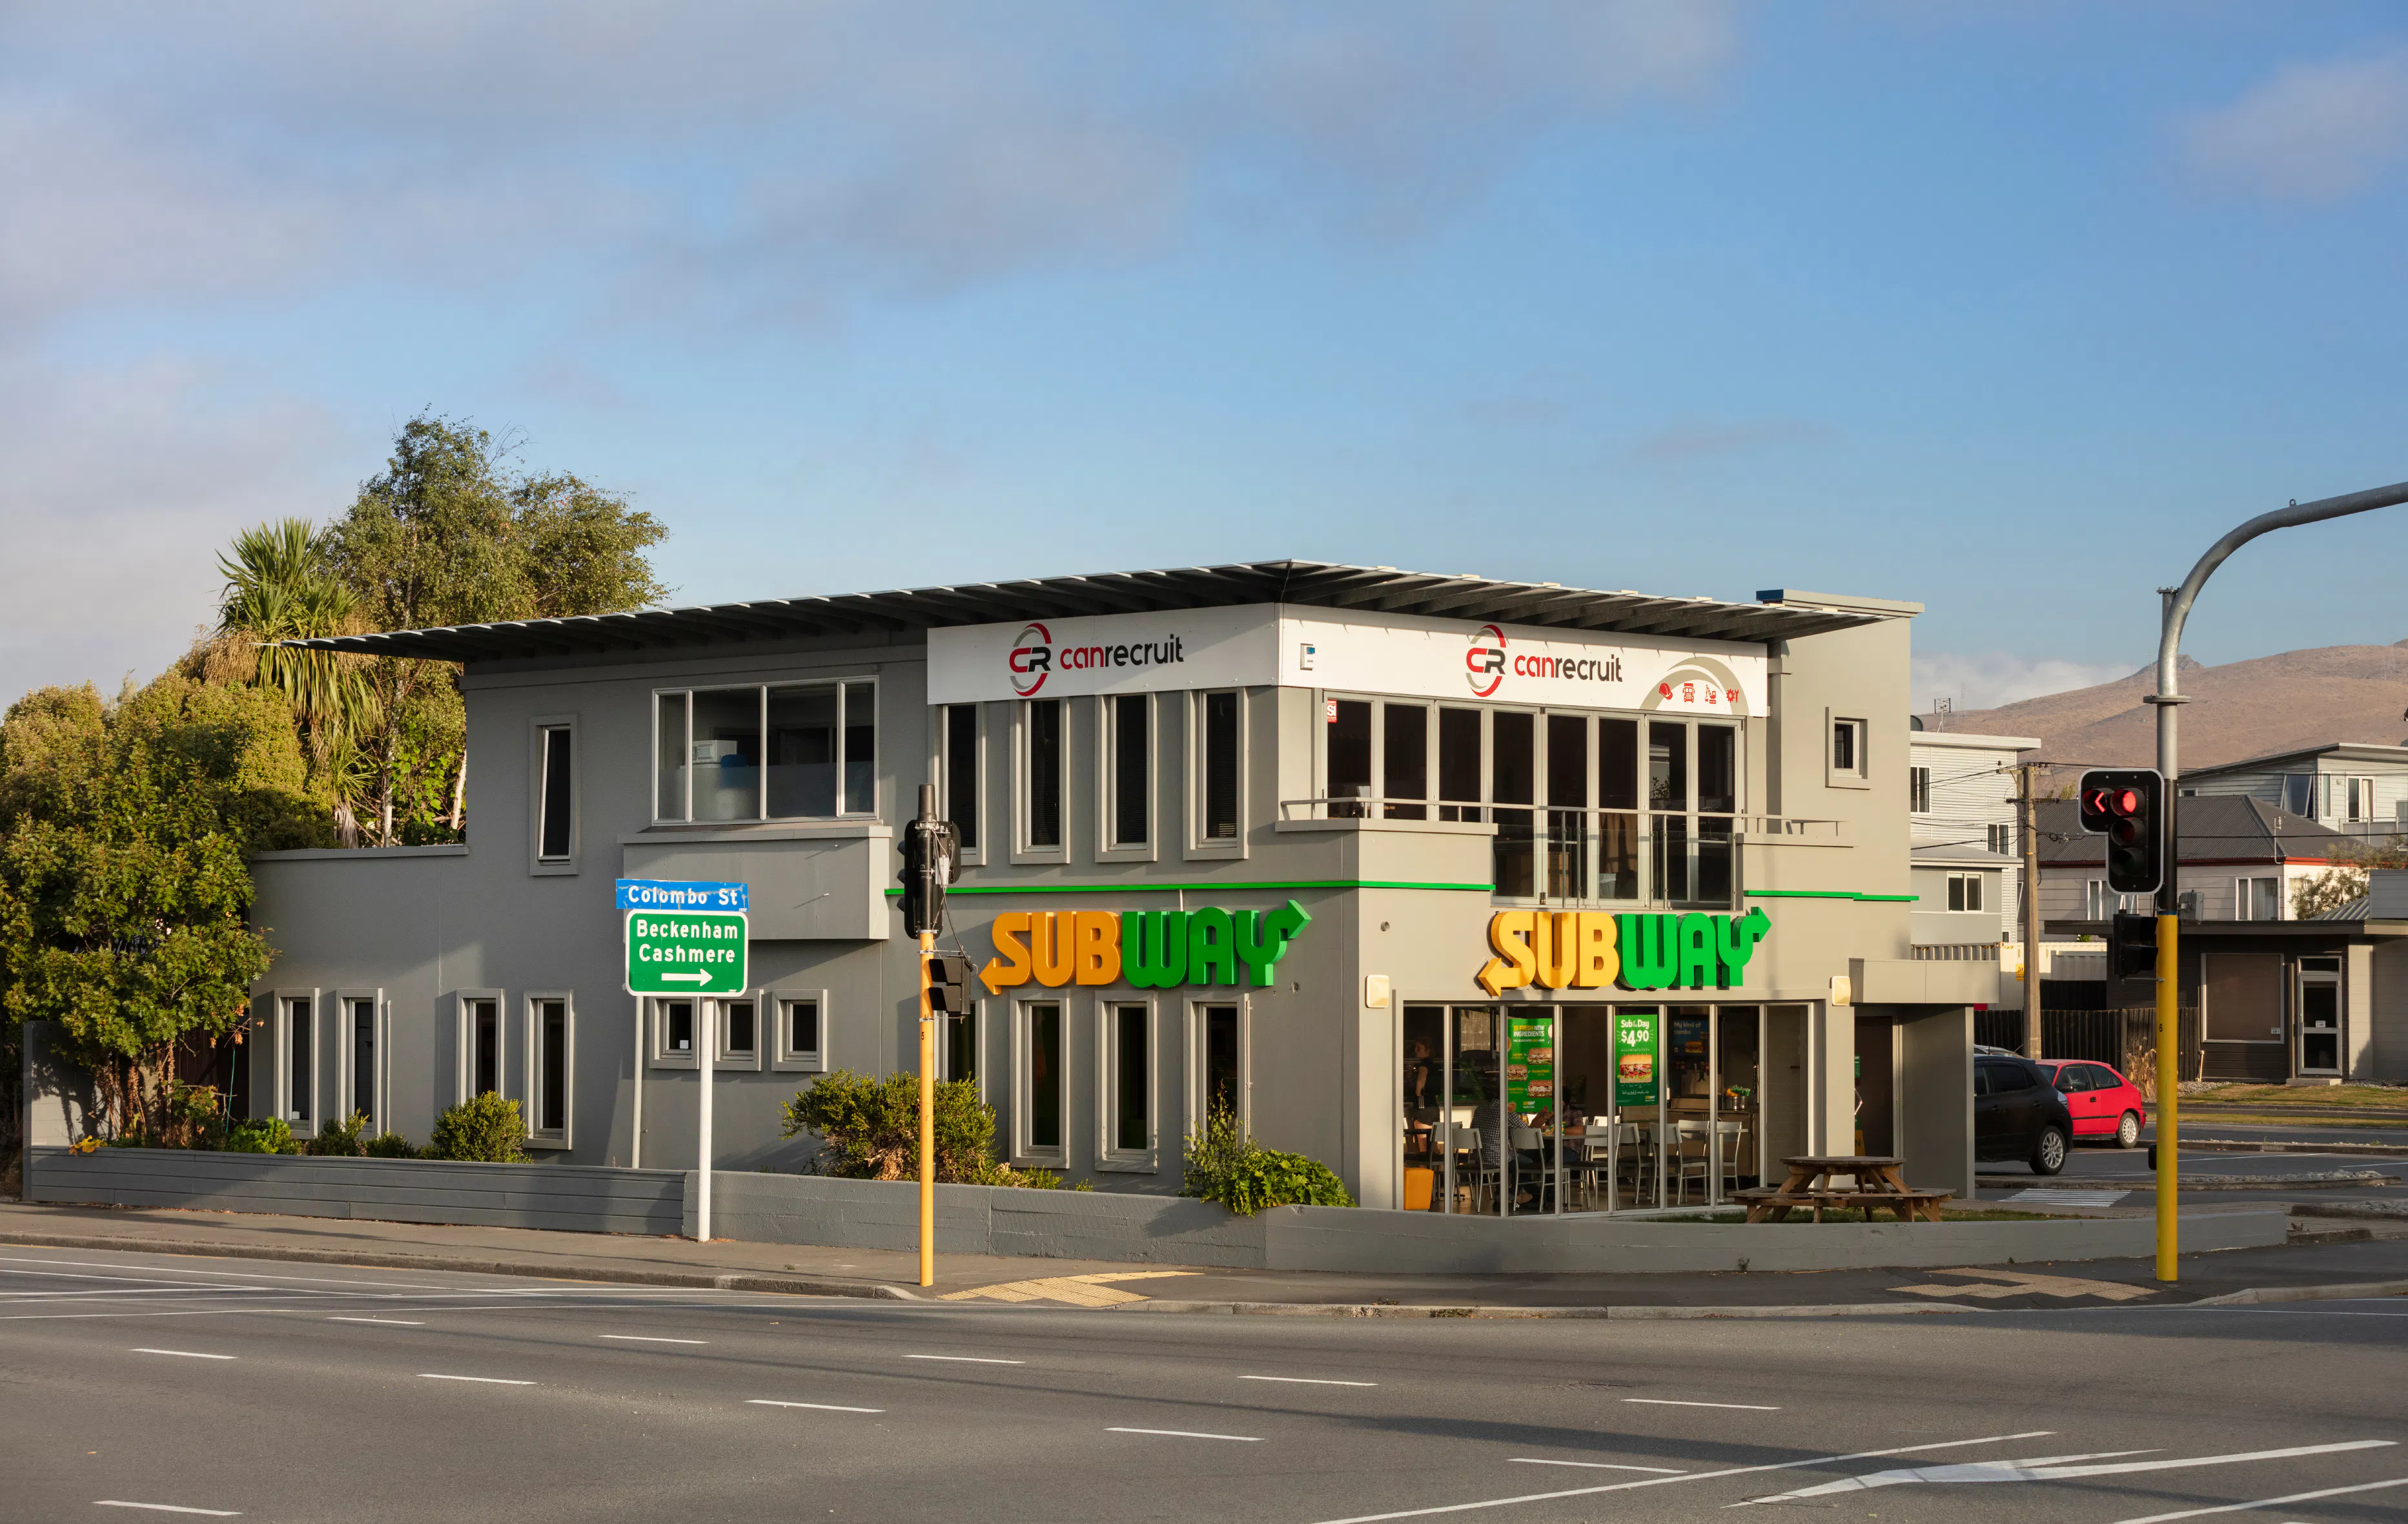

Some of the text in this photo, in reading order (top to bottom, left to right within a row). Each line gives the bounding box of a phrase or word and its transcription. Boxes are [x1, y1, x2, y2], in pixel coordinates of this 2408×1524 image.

[1009, 633, 1184, 672] CR canrecruit
[1466, 647, 1622, 682] CR canrecruit
[628, 885, 738, 905] Colombo St
[637, 920, 738, 939] Beckenham
[638, 944, 735, 963] Cashmere
[978, 900, 1312, 995] SUBWAY
[1477, 906, 1772, 996] SUBWAY
[1621, 1019, 1633, 1028] Sub
[1637, 1019, 1649, 1029] Day
[2159, 1023, 2163, 1033] 6
[1621, 1029, 1649, 1047] $4.90
